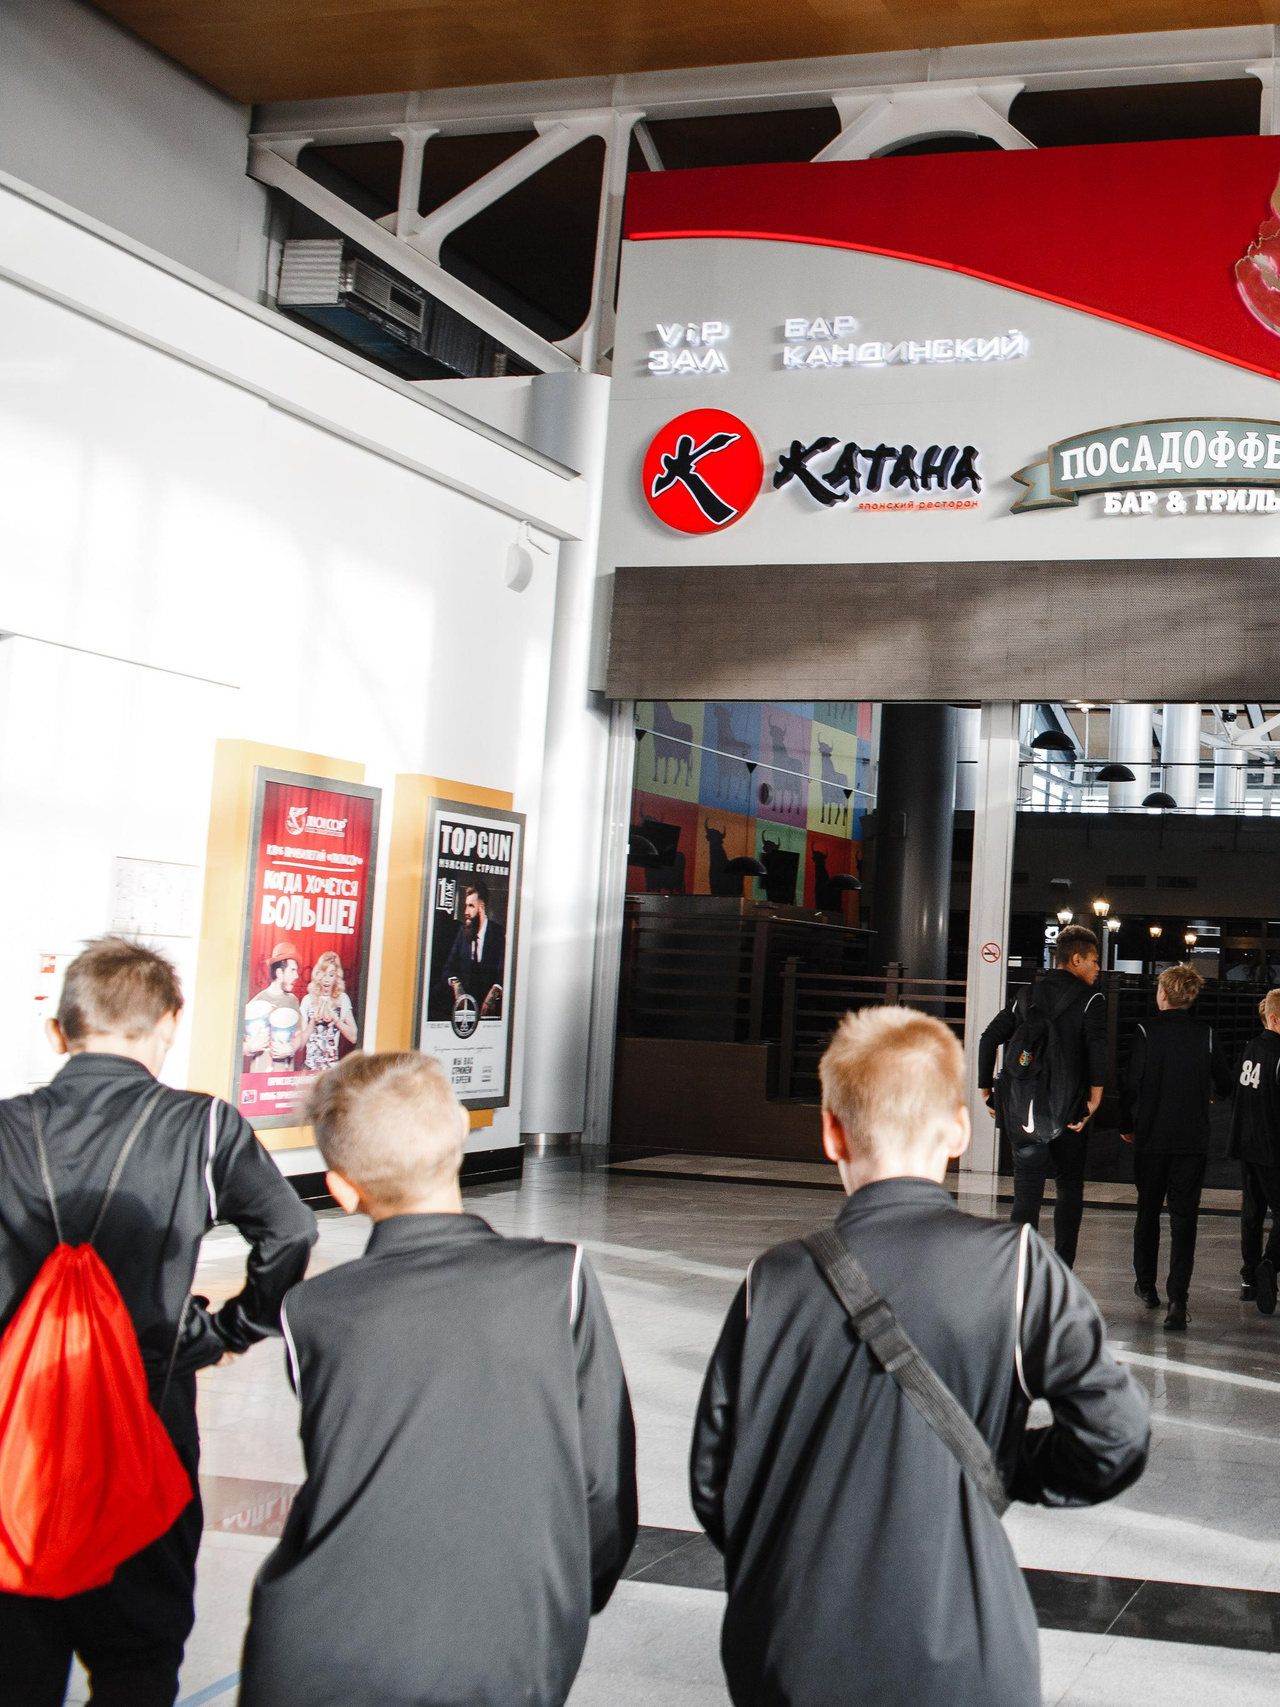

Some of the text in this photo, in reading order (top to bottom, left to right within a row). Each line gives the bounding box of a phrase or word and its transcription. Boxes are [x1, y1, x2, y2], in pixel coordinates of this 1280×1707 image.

[784, 314, 862, 342] БАР
[647, 348, 731, 376] ЗАЛ
[782, 328, 1031, 371] КАНДИНСКИЙ
[858, 500, 979, 511] японский ресторан
[1103, 490, 1159, 515] БАР
[1165, 490, 1188, 515] &
[263, 870, 359, 897] КОГДА ХОЧЕТСЯ
[260, 894, 358, 935] БОЛЬШЕ!
[1239, 1060, 1261, 1089] 84
